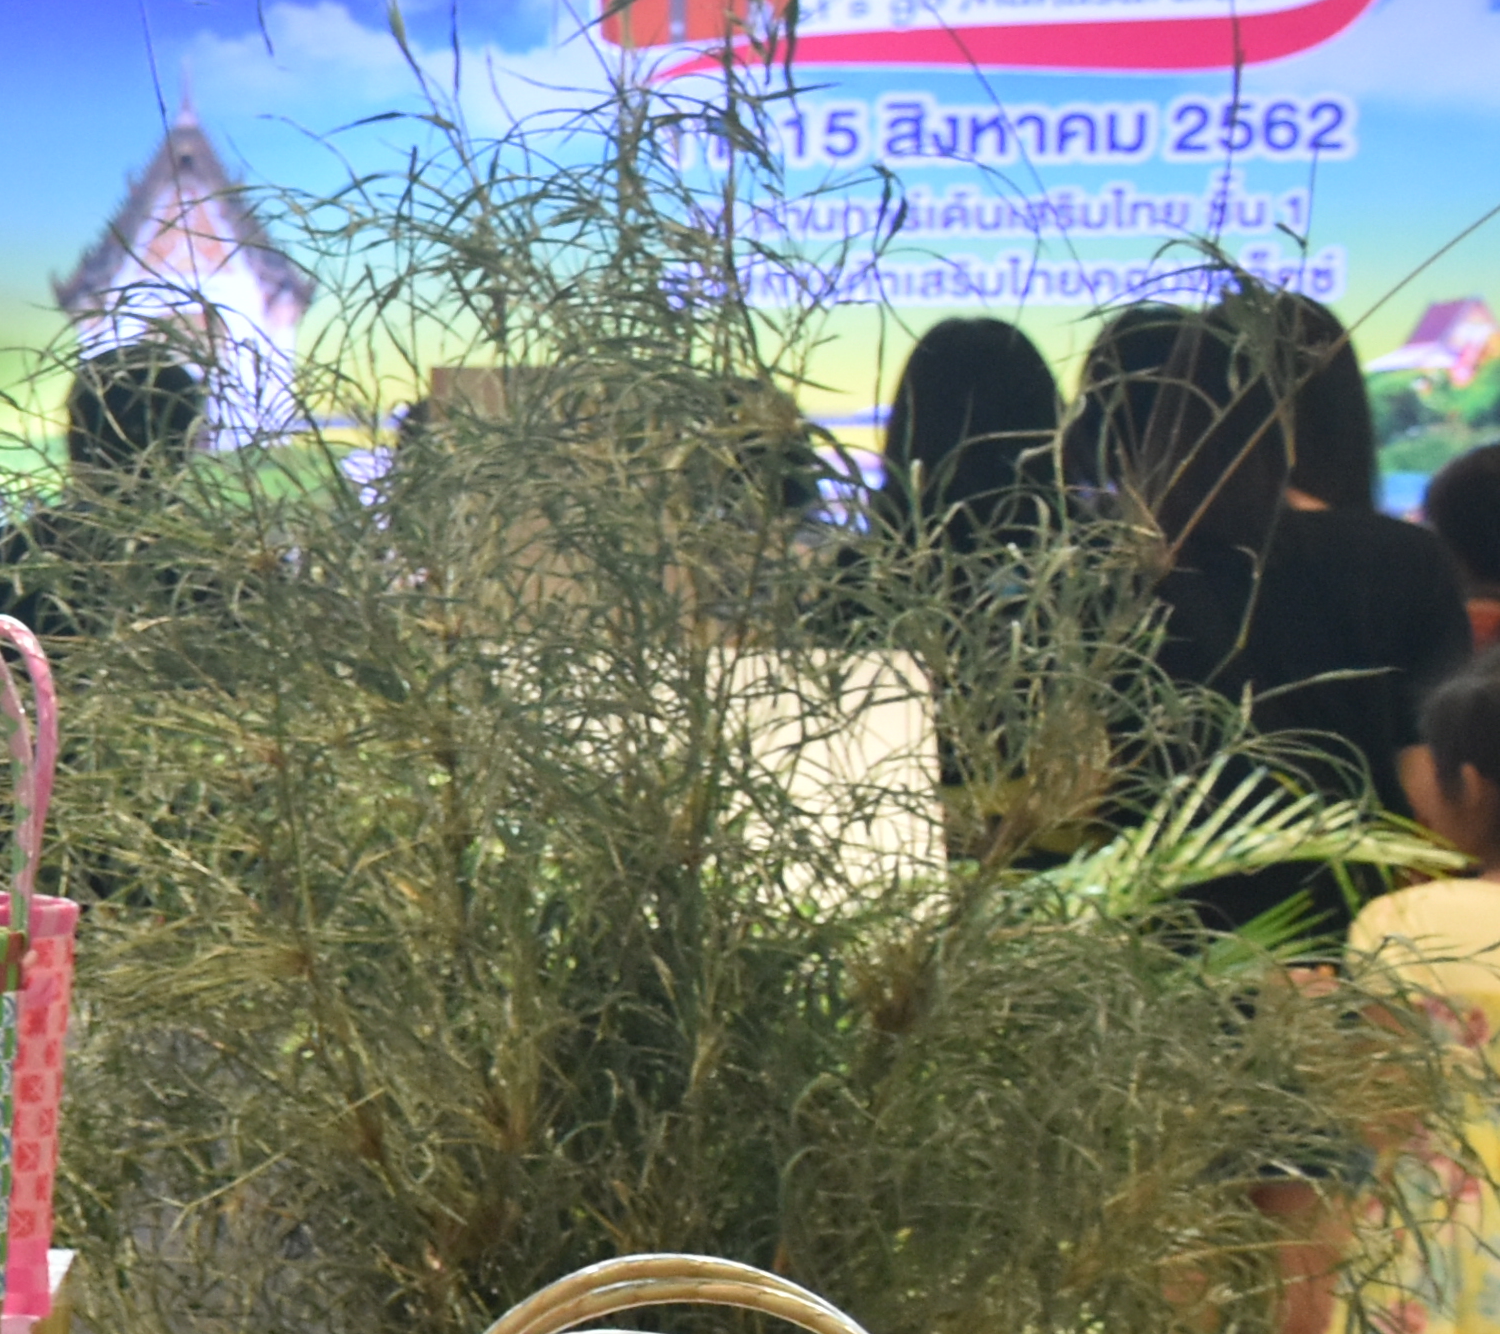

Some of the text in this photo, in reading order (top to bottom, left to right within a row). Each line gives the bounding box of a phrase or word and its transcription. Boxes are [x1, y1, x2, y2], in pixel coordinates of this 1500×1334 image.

[886, 101, 1148, 159] สิงหาคม
[1172, 103, 1346, 152] 2562
